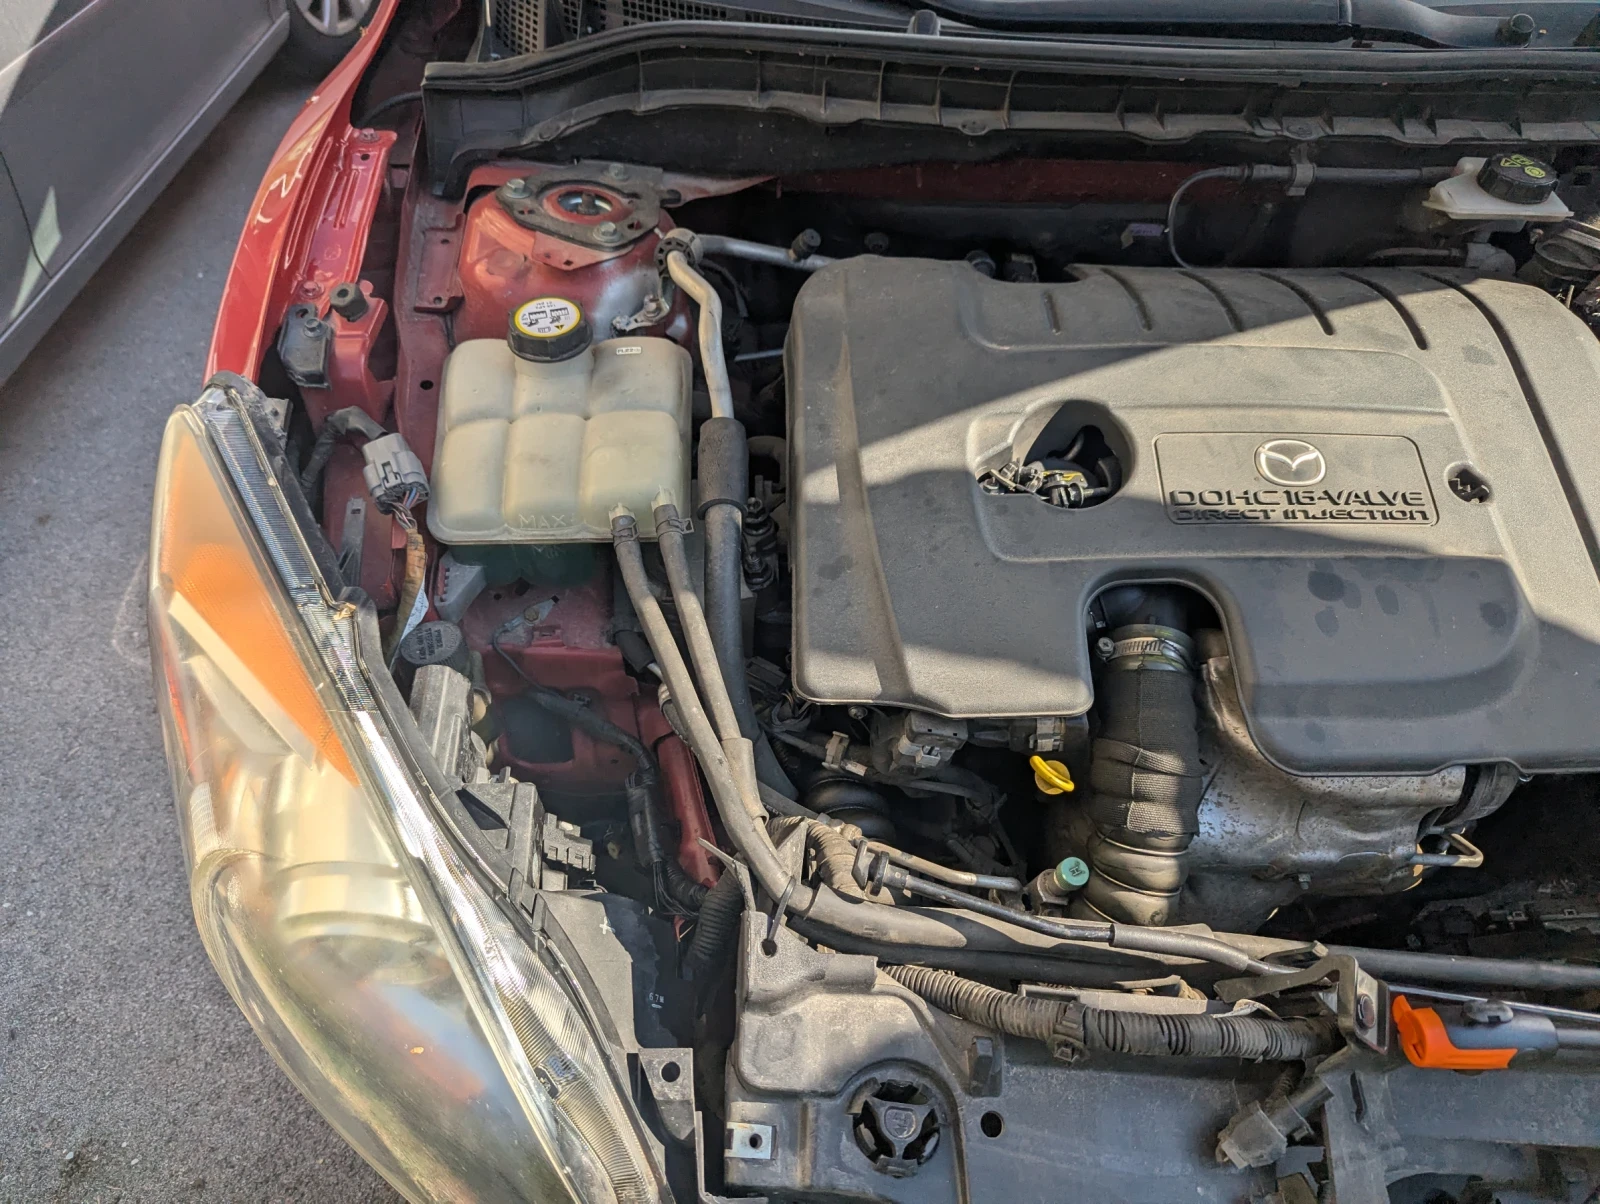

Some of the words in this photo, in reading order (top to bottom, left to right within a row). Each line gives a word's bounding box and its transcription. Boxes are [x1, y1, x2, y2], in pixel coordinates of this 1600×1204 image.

[1169, 489, 1281, 507] DOHC
[1284, 489, 1426, 507] 16-VALVE
[518, 513, 567, 529] MAX
[1174, 508, 1276, 521] DIRECT
[1282, 508, 1431, 521] INJECTION
